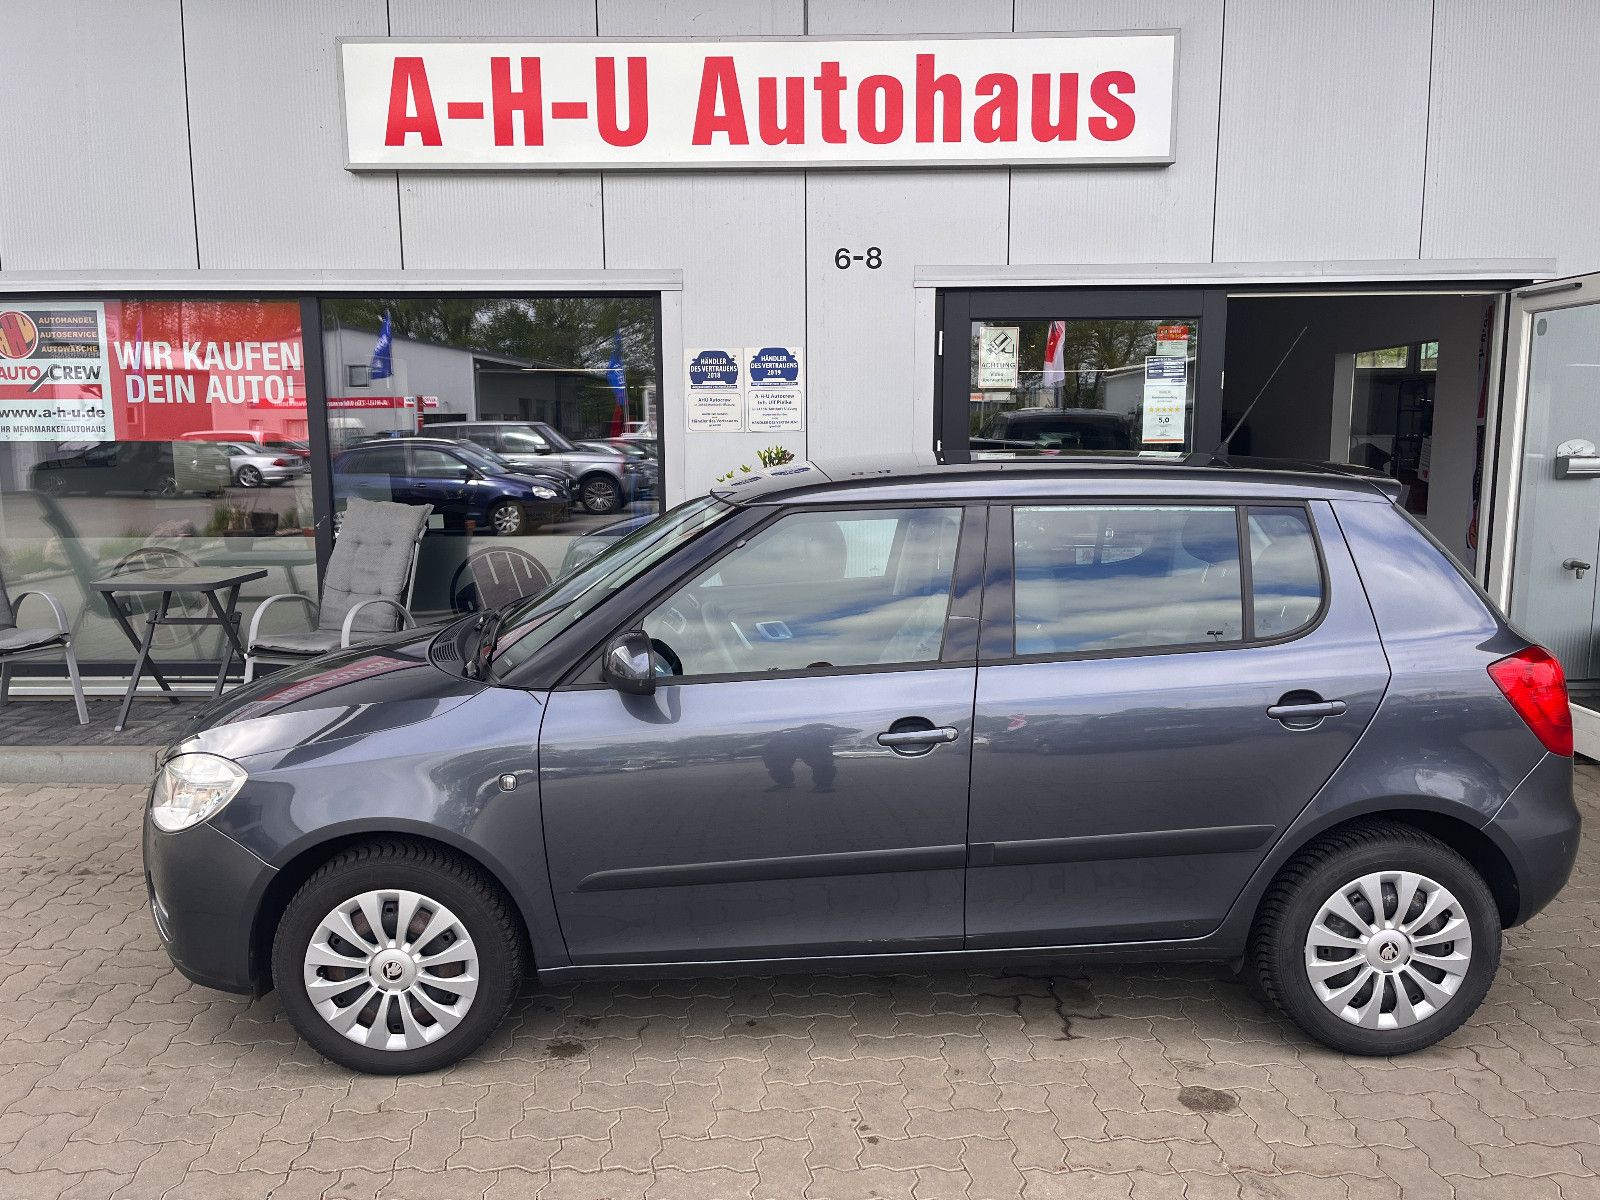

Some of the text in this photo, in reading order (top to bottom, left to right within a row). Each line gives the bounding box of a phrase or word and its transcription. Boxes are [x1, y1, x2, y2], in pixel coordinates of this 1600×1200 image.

[385, 53, 1136, 147] A-H-U Autohaus
[835, 247, 882, 269] 6-8
[39, 316, 95, 324] AUTOHANDEL
[41, 344, 98, 353] AUTOWÄSCHE
[113, 341, 301, 372] WIR KAUFEN
[700, 357, 727, 365] HÄNDLER
[48, 364, 102, 380] CREW
[126, 375, 296, 404] DEIN AUTO!
[0, 407, 105, 418] www.a-h-u.de
[13, 425, 106, 433] MEHRMARKENAUTOHAUS
